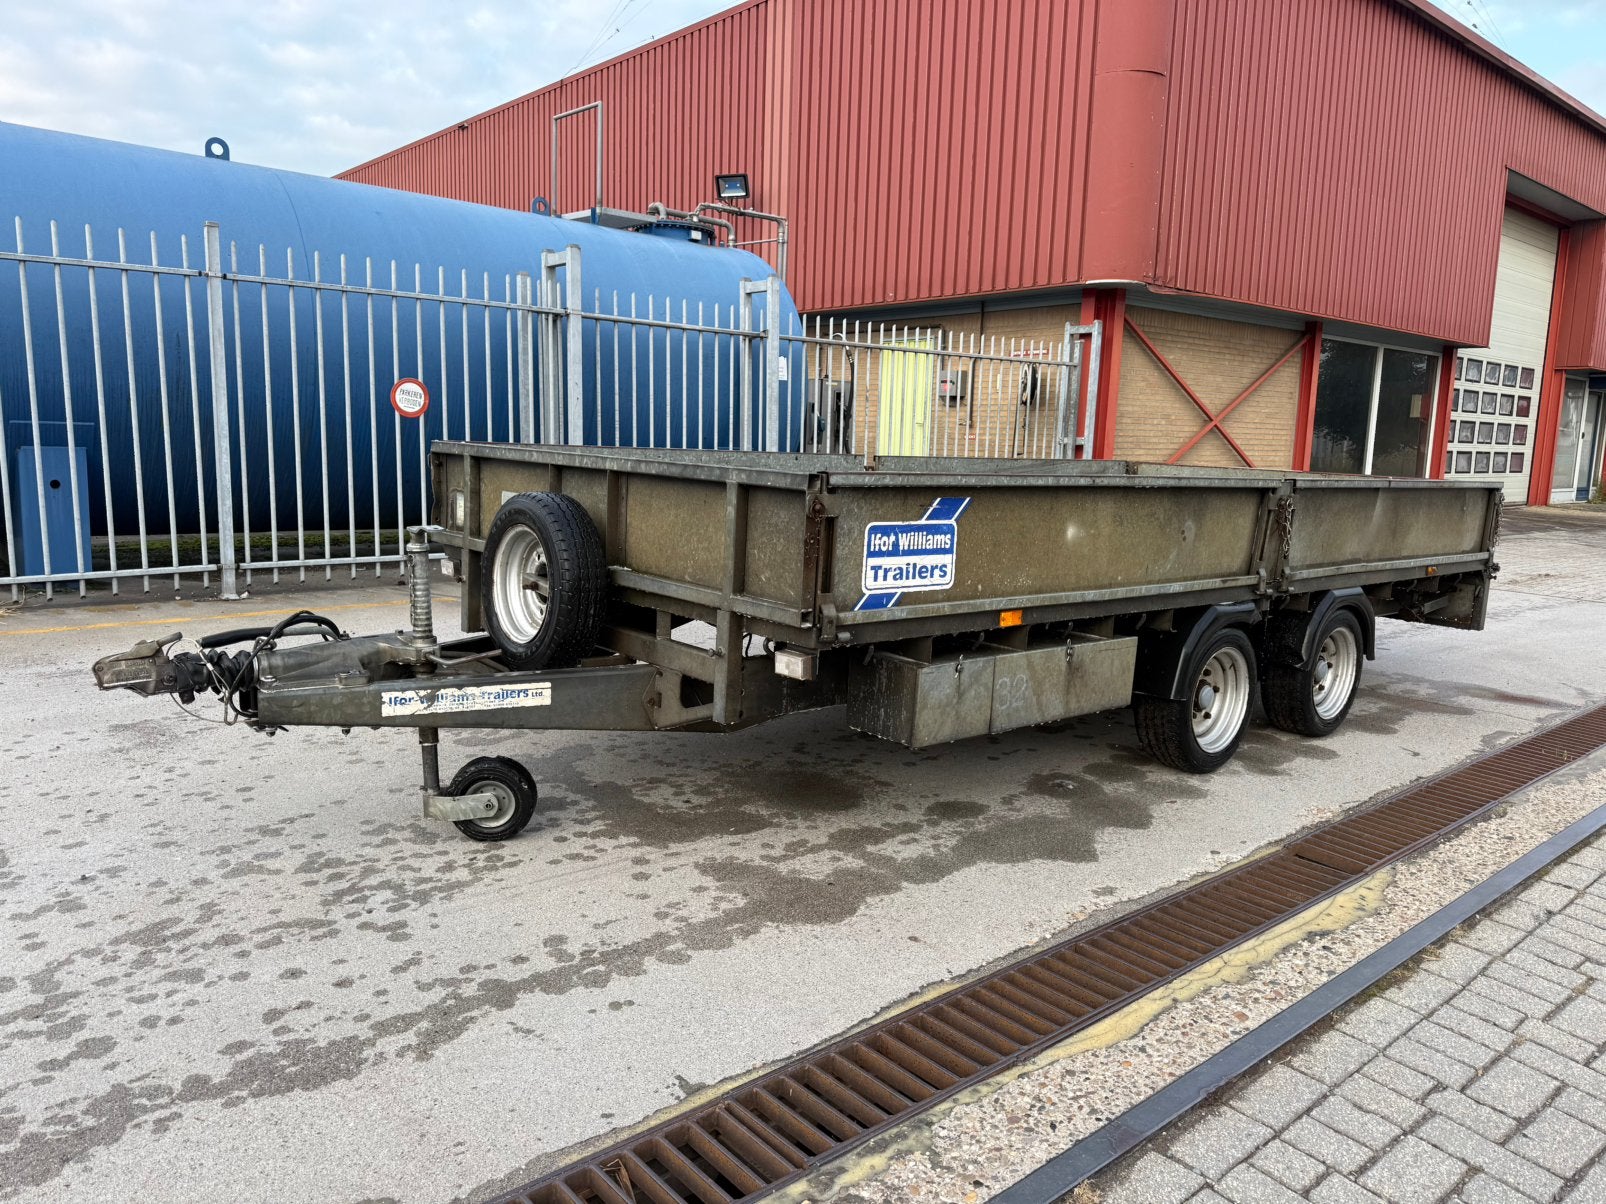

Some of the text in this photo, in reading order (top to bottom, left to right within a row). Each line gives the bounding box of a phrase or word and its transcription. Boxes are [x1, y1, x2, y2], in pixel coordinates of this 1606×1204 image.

[870, 531, 951, 552] Ifor Williams
[870, 562, 948, 582] Trailers
[389, 696, 414, 706] Ifor
[480, 689, 529, 700] Trailers
